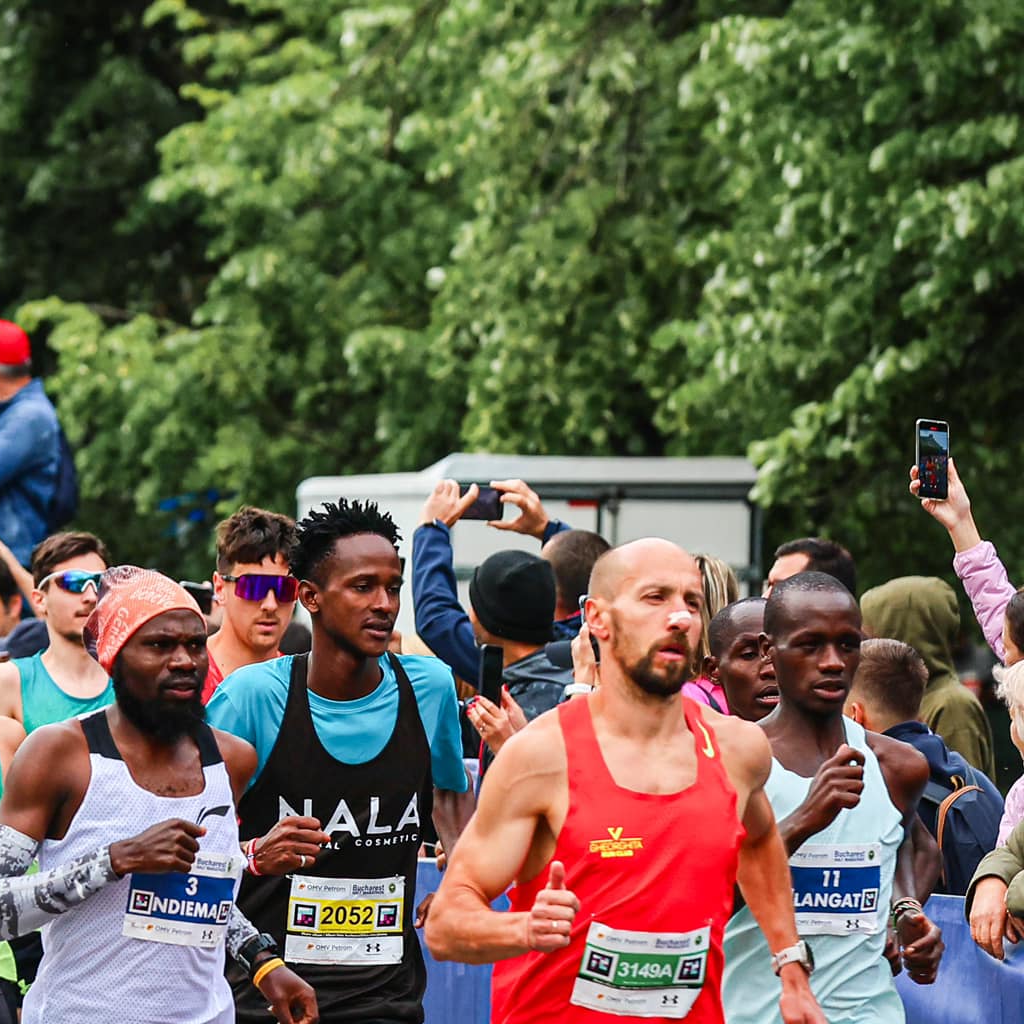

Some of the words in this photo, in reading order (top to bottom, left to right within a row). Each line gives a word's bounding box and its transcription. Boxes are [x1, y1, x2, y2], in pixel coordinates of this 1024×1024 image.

[279, 792, 420, 837] NALA
[185, 876, 198, 896] 3
[823, 870, 840, 887] 11
[152, 897, 217, 919] NDIEMA
[793, 892, 861, 908] LANGAT
[321, 906, 373, 925] 2052
[617, 961, 673, 978] 3149A
